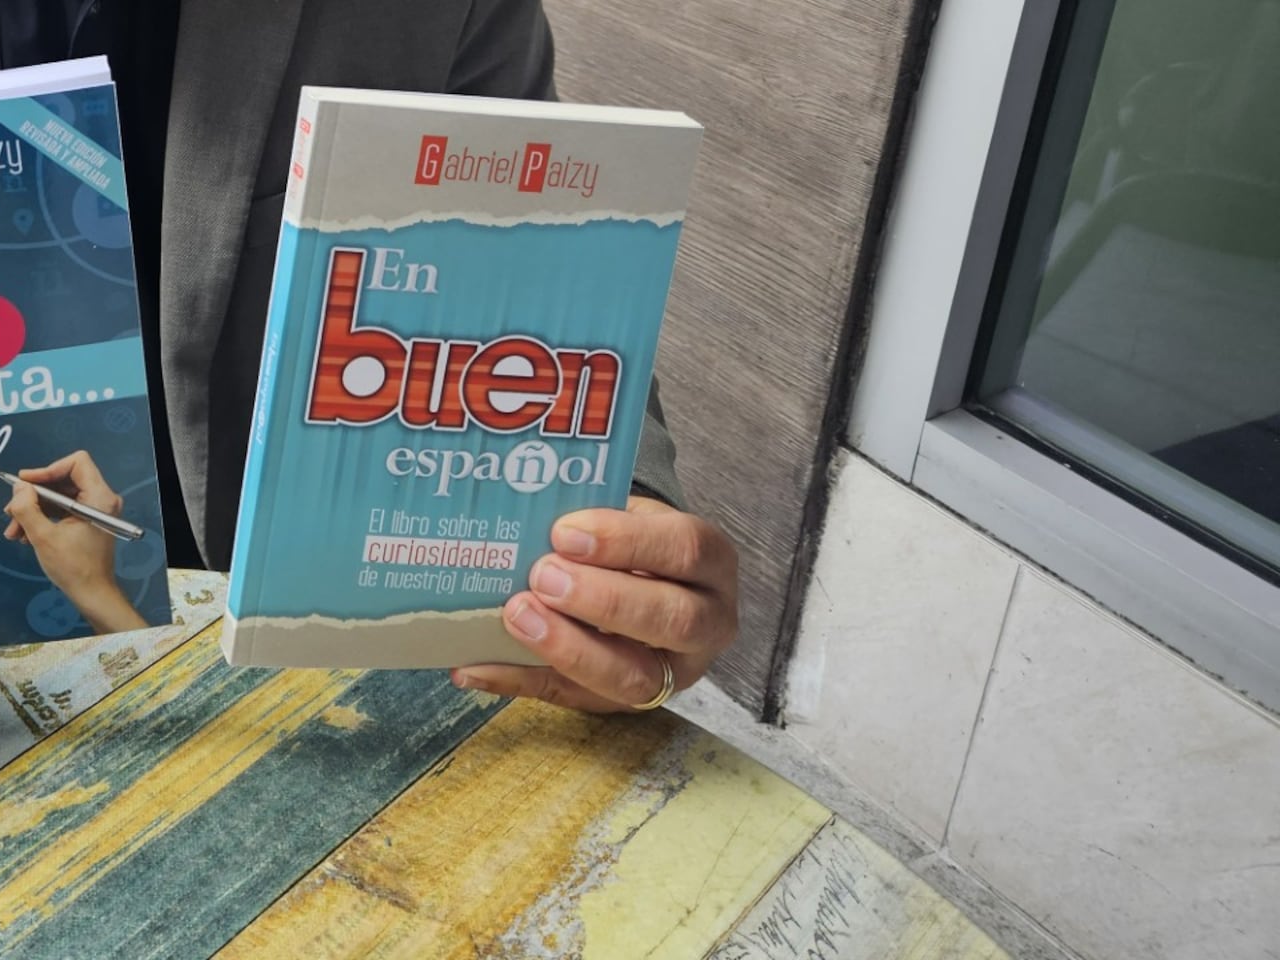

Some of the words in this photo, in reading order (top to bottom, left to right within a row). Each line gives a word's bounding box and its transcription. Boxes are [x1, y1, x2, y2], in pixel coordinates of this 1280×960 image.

[420, 141, 519, 185] Gabriel
[523, 149, 600, 199] Paizy
[366, 246, 439, 294] En
[304, 245, 623, 439] buen
[385, 440, 610, 498] español
[368, 508, 385, 534] El
[391, 509, 430, 536] libro
[437, 513, 489, 538] sobre
[494, 515, 521, 540] las
[367, 539, 513, 569] curiosidades
[358, 566, 378, 588] de
[384, 569, 457, 595] nuestr[o]
[462, 571, 513, 594] idioma
